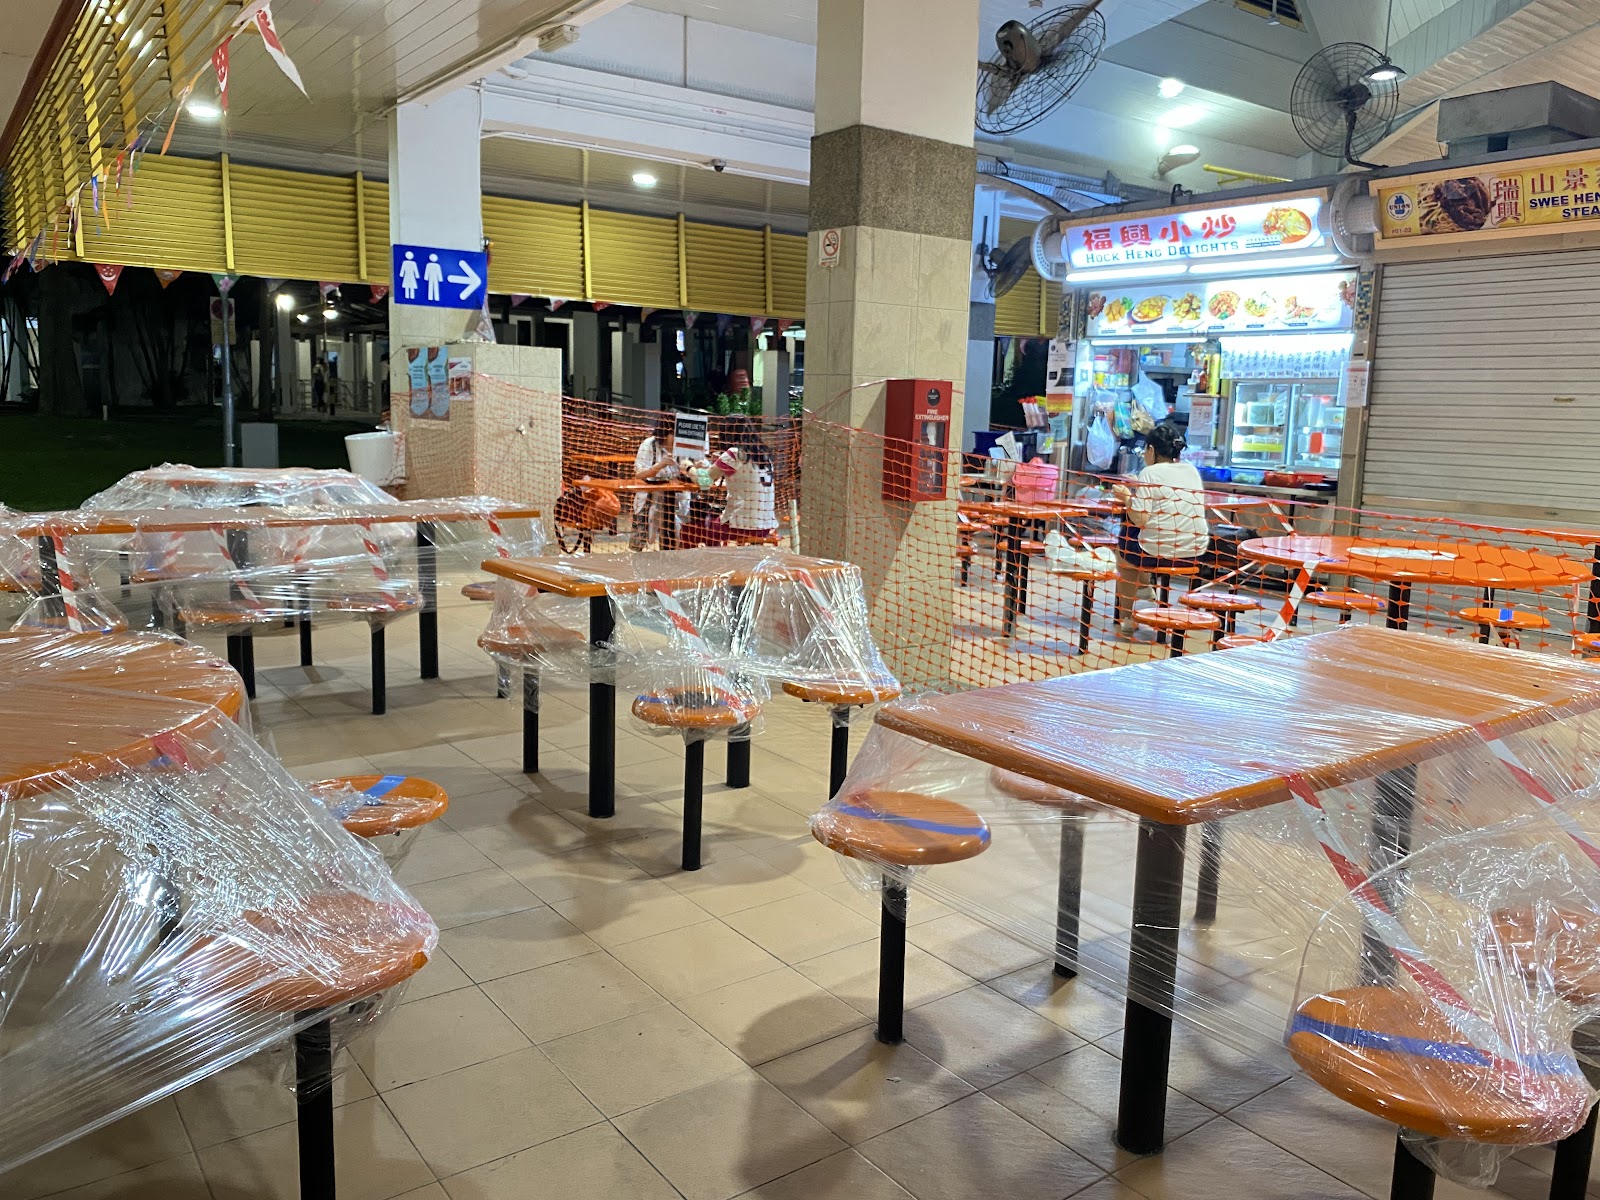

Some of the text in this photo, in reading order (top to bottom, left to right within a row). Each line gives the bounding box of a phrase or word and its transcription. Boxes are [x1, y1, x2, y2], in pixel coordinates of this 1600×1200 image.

[1494, 178, 1521, 224] 瑞興
[1529, 195, 1569, 209] SWEE
[1562, 206, 1600, 219] STEA
[1083, 214, 1236, 251] 福興小炒
